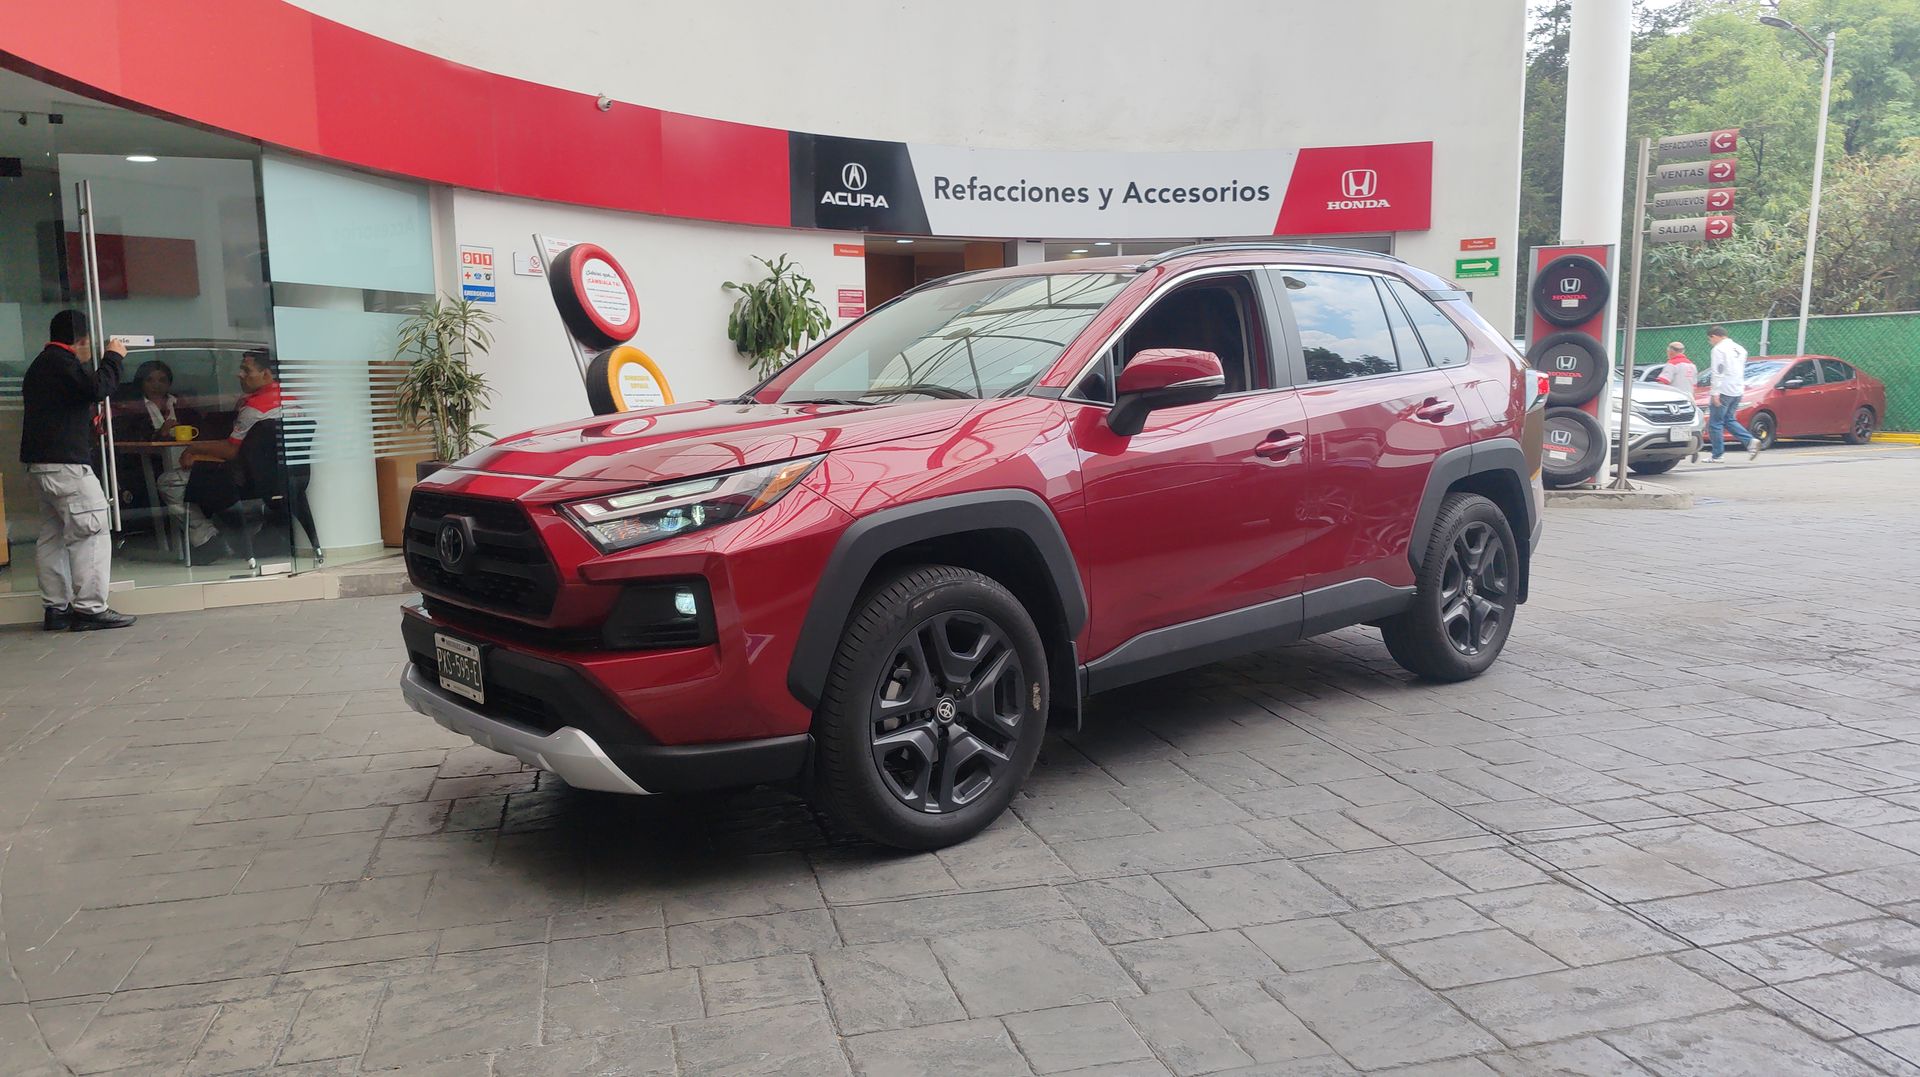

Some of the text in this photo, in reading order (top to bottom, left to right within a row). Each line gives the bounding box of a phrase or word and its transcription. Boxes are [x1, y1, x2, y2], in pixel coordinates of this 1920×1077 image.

[1661, 168, 1705, 179] VENTAS
[934, 175, 1270, 211] Refacciones y Accesorios
[820, 190, 890, 209] ACURA
[1326, 199, 1391, 210] HONDA
[1655, 196, 1705, 208] SEMINUEVOS
[1658, 225, 1697, 235] SALIDA
[463, 253, 492, 266] 911
